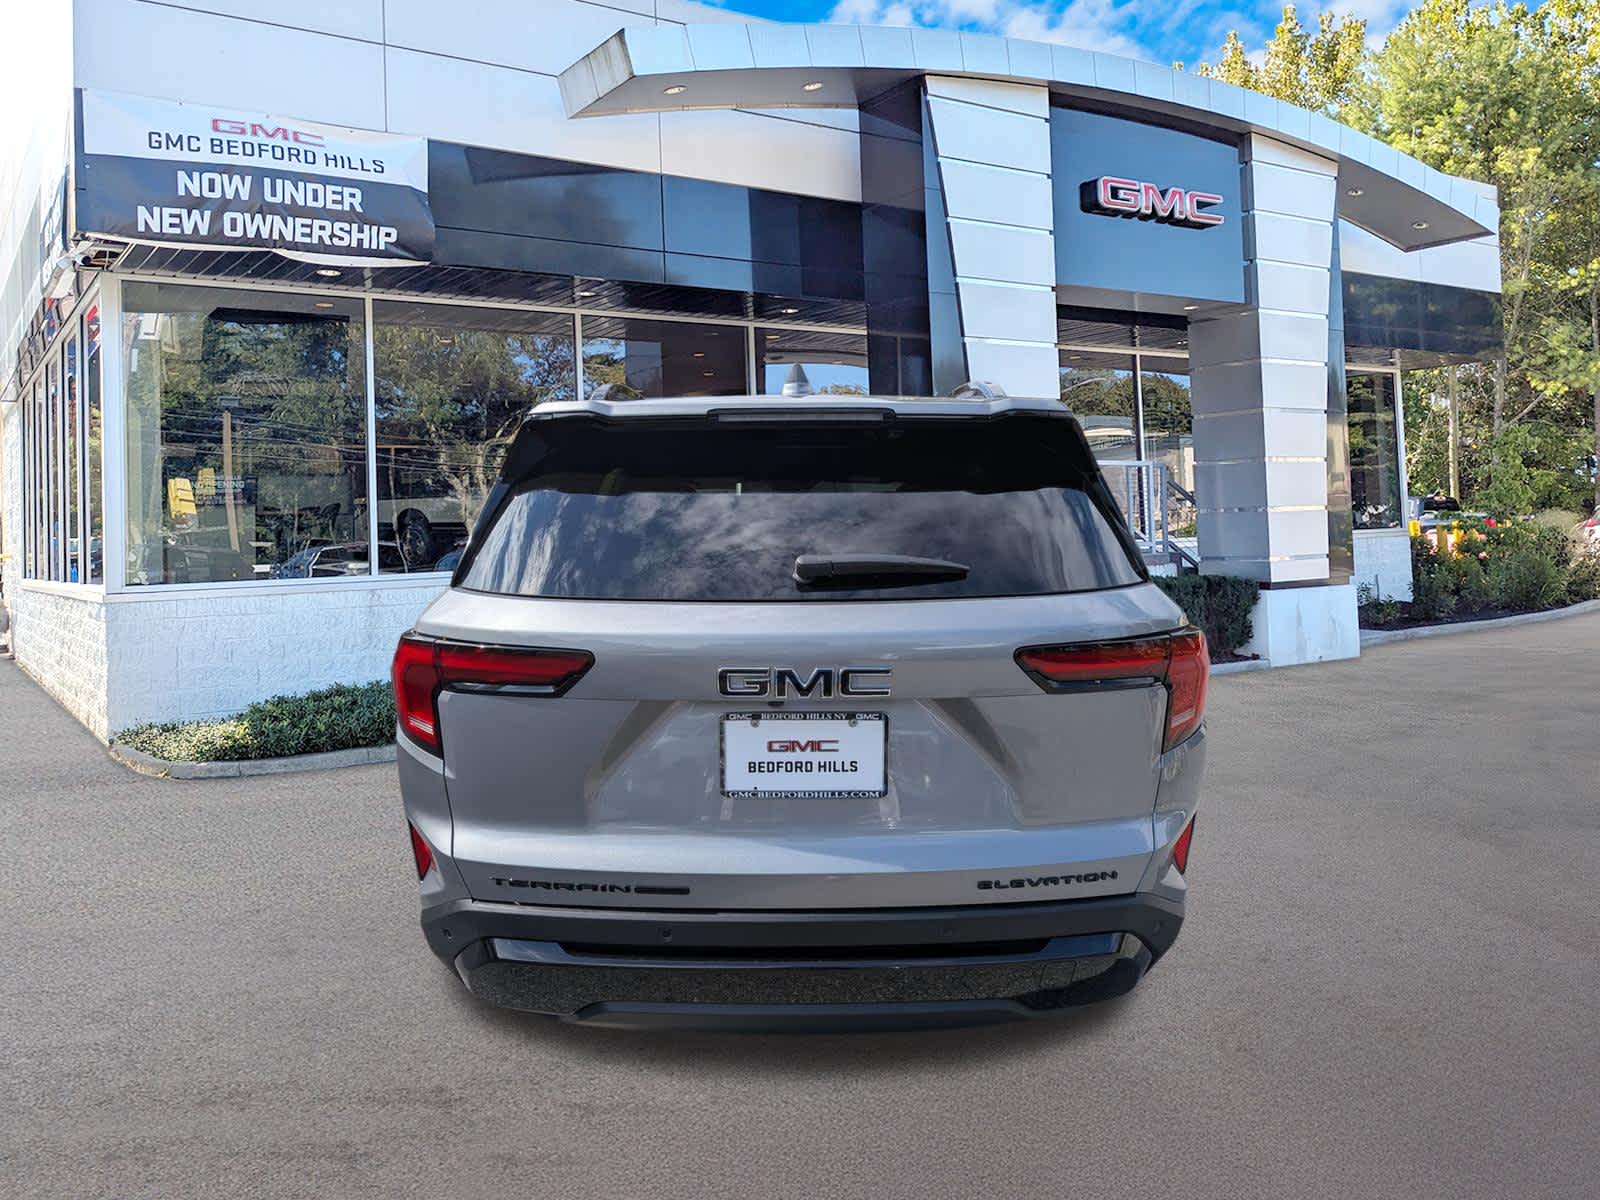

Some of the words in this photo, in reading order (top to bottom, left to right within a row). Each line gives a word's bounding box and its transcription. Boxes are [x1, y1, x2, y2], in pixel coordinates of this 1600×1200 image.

[211, 118, 326, 148] GMC
[148, 131, 201, 152] GMC
[210, 138, 316, 165] BEDFORD
[324, 152, 385, 174] HILLS
[176, 170, 252, 201] NOW
[263, 176, 363, 213] UNDER
[1097, 176, 1225, 225] GMC
[136, 205, 211, 236] NEW
[223, 211, 398, 250] OWNERSHIP
[717, 665, 893, 699] GMC
[728, 713, 752, 721] GMC
[760, 712, 804, 720] BEDFORD
[806, 712, 832, 720] HILLS
[833, 712, 848, 720] NY
[855, 712, 880, 721] GMC
[766, 740, 840, 753] GMC
[748, 761, 813, 774] BEDFORD
[818, 761, 858, 773] HILLS
[491, 876, 632, 894] TERRAIN
[977, 870, 1119, 890] ELEVATION
